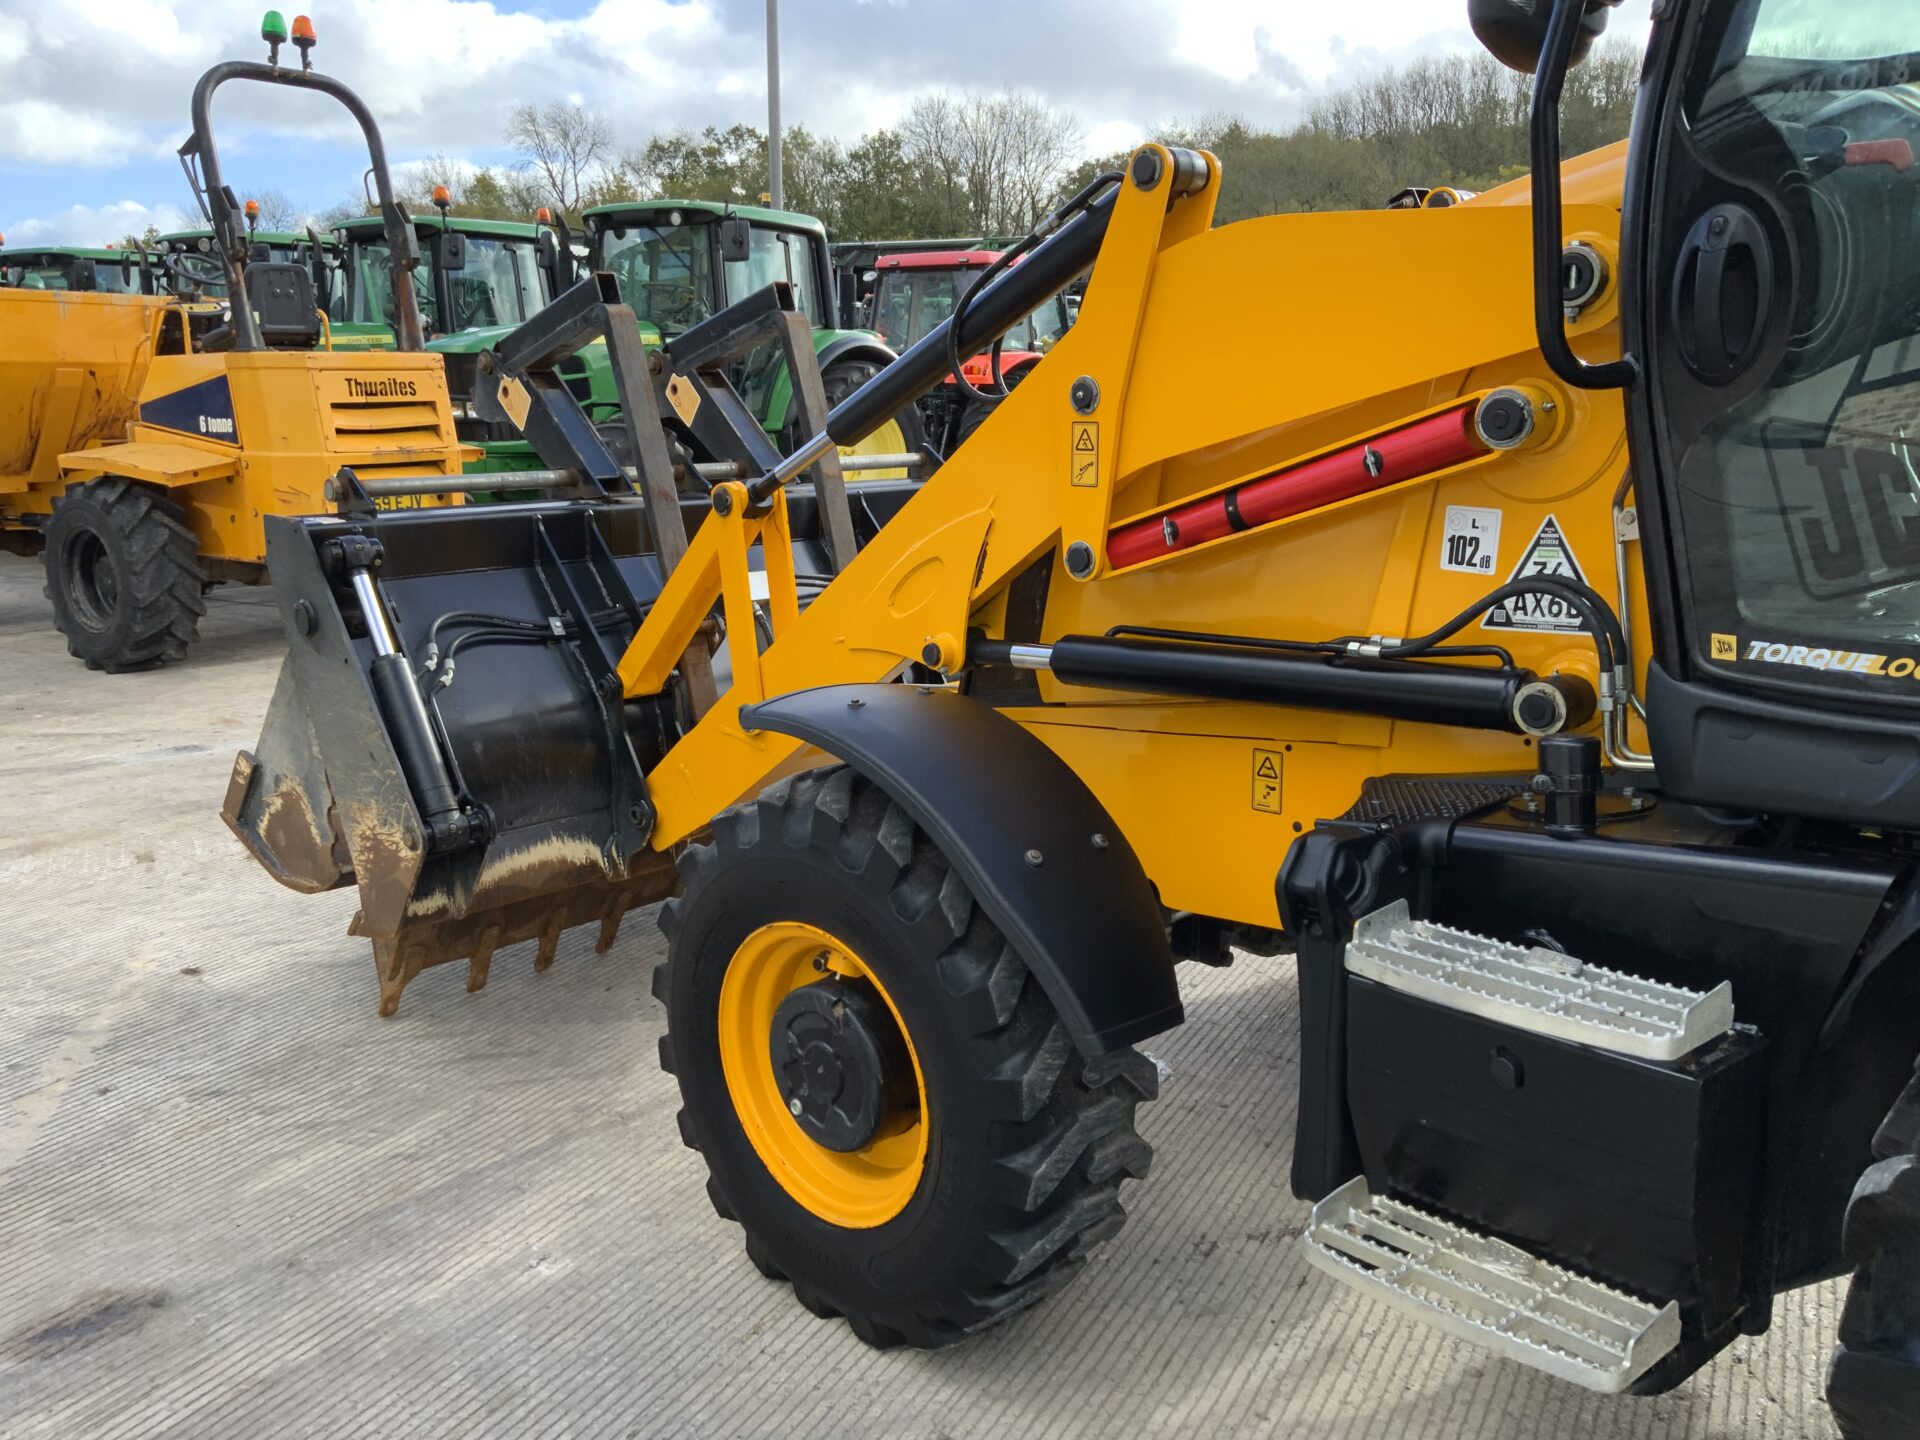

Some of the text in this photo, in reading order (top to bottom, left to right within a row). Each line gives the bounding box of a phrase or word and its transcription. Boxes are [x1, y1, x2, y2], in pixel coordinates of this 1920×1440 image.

[344, 378, 417, 397] Thwaites
[199, 415, 233, 433] 6 tonne
[372, 496, 391, 510] 59
[1801, 445, 1920, 580] JC
[1472, 518, 1480, 529] L
[1447, 534, 1491, 569] 102 dB
[1716, 640, 1733, 654] JCB
[1748, 640, 1920, 681] TORQUELO
